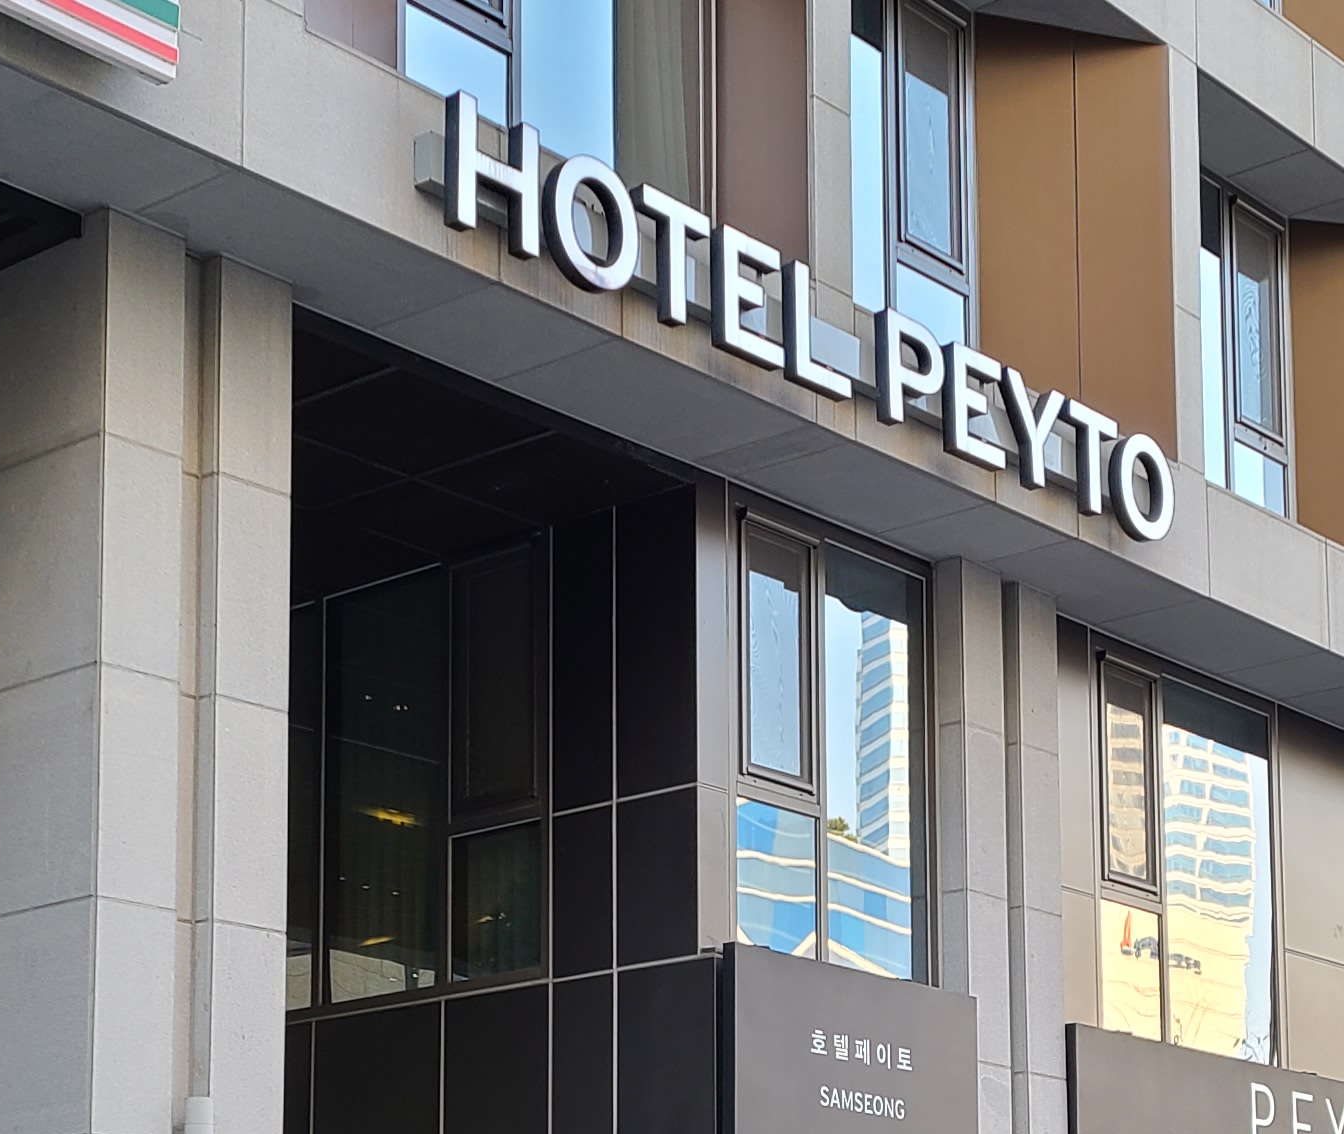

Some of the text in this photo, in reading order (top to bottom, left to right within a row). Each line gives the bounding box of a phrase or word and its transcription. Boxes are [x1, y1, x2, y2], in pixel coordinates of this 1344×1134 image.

[445, 89, 1176, 542] HOTEL PEYTO
[810, 1030, 914, 1074] 호텔페이토
[819, 1085, 906, 1121] SAMSEONG
